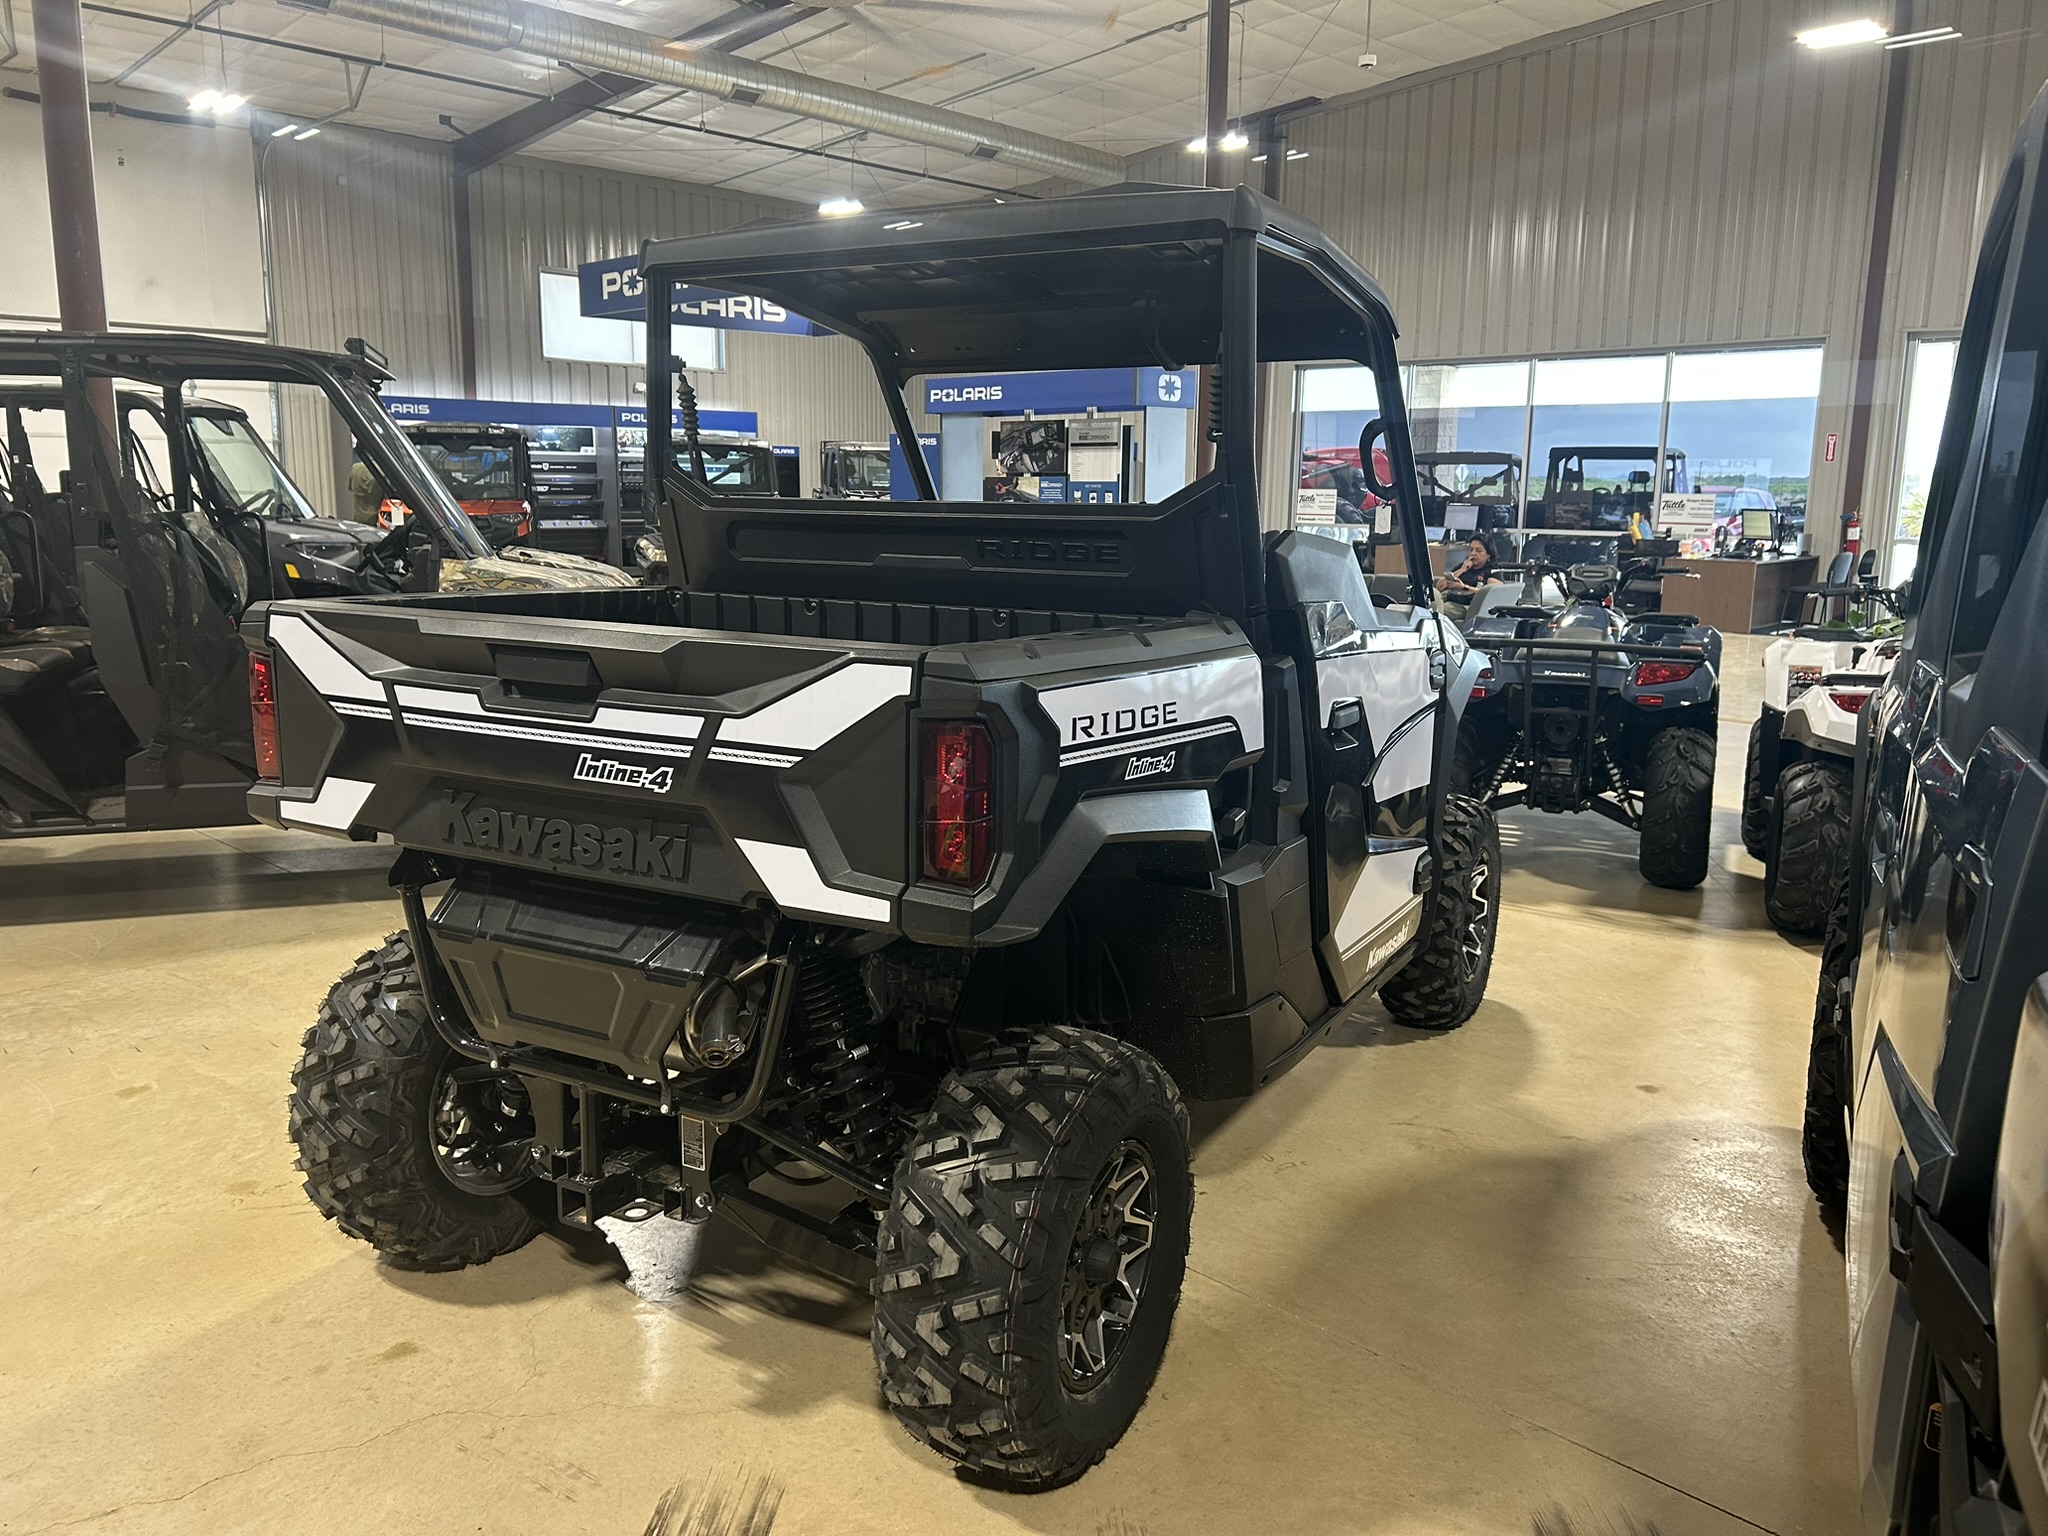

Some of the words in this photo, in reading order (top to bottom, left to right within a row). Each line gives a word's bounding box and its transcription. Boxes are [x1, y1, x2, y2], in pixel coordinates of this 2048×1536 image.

[671, 295, 787, 323] LARIS
[930, 386, 1002, 402] POLARIS
[384, 402, 431, 415] ARIS
[621, 412, 678, 424] POLS
[1662, 499, 1685, 510] Tuttle
[976, 539, 1122, 564] RIDGE
[1071, 701, 1178, 741] RIDGE
[573, 753, 674, 793] Inline-4
[1124, 750, 1176, 781] Inline-4
[441, 789, 690, 883] Kawasaki
[1366, 920, 1409, 972] Kawasaki
